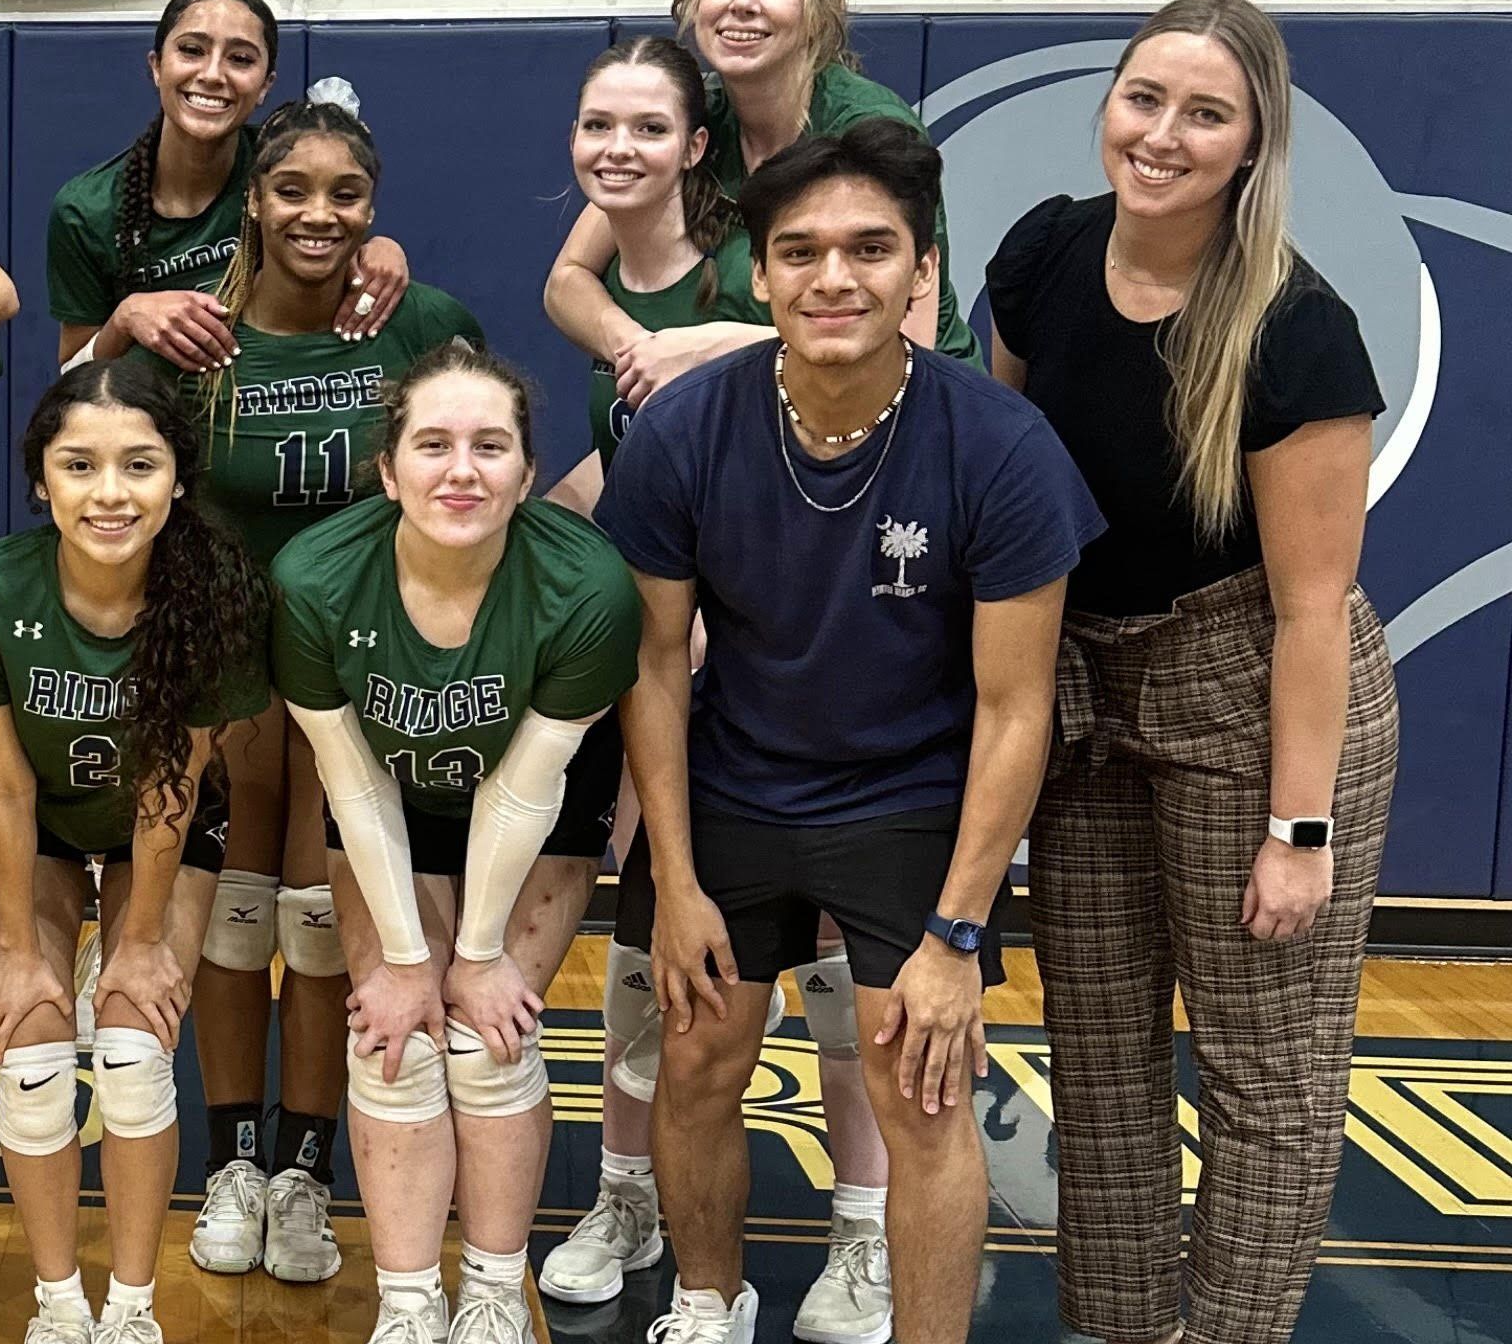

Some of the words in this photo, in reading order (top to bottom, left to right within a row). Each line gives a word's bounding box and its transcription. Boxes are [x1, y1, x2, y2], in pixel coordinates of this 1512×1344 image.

[237, 365, 385, 416] RIDGE
[272, 428, 354, 507] 11
[364, 672, 508, 737] RIDGE
[68, 734, 122, 789] 2
[385, 746, 485, 789] 13
